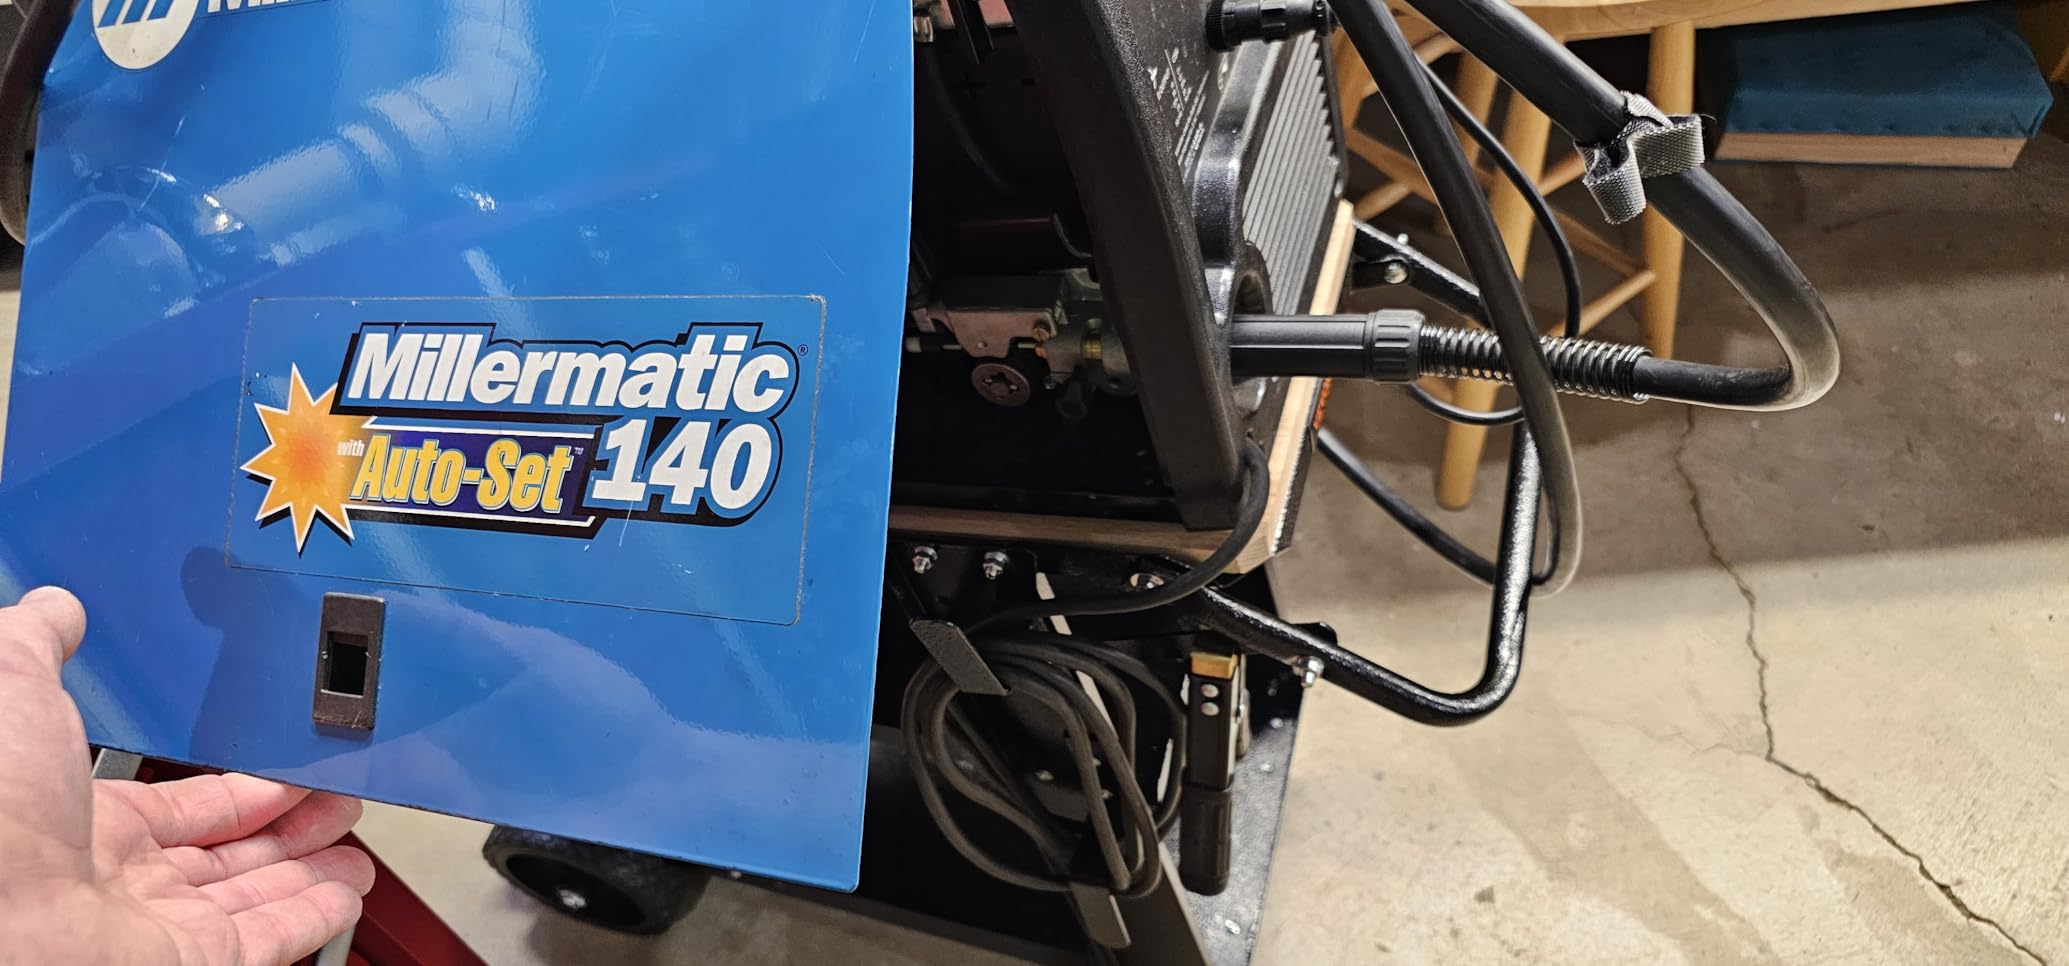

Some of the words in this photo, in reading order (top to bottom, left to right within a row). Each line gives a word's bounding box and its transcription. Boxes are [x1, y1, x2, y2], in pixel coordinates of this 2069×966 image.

[348, 333, 789, 413] Millermatic
[337, 440, 365, 457] with
[349, 433, 575, 513] Auto-Set
[592, 419, 772, 510] 140
